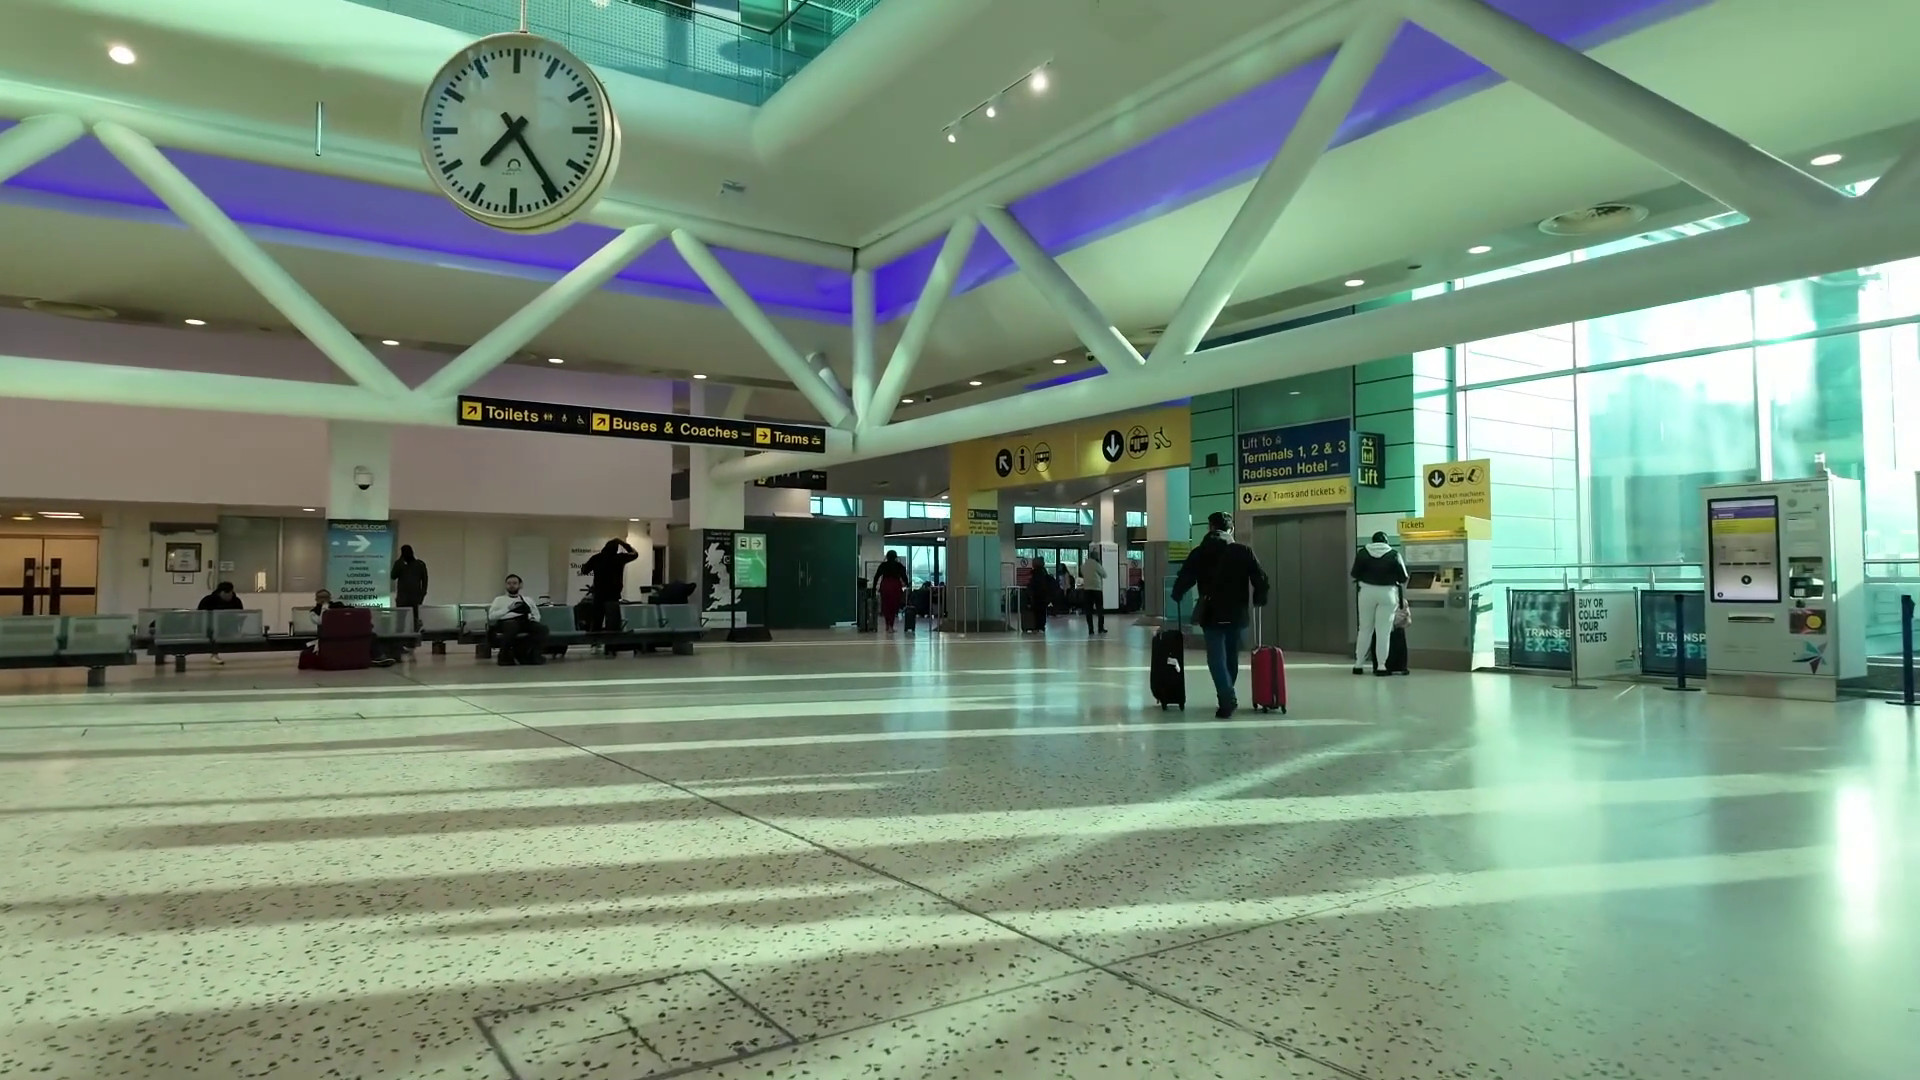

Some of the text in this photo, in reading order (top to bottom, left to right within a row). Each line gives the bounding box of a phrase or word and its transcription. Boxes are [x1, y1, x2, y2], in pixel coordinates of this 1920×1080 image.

[486, 405, 539, 424] Toilets
[612, 417, 739, 440] Buses & Coaches
[774, 431, 809, 446] Trams
[1242, 436, 1273, 450] Lift to
[1242, 440, 1347, 465] Terminals 1, 2 & 3
[1242, 459, 1328, 480] Radisson Hotel
[1357, 467, 1378, 486] Lift
[1273, 486, 1336, 500] Trams and tickets
[1401, 521, 1425, 529] Tickets
[1578, 598, 1604, 609] BUY OR
[1578, 609, 1609, 620] COLLECT
[1578, 621, 1599, 632] YOUR
[1579, 632, 1608, 643] TICKETS
[1658, 631, 1707, 643] TRNSP
